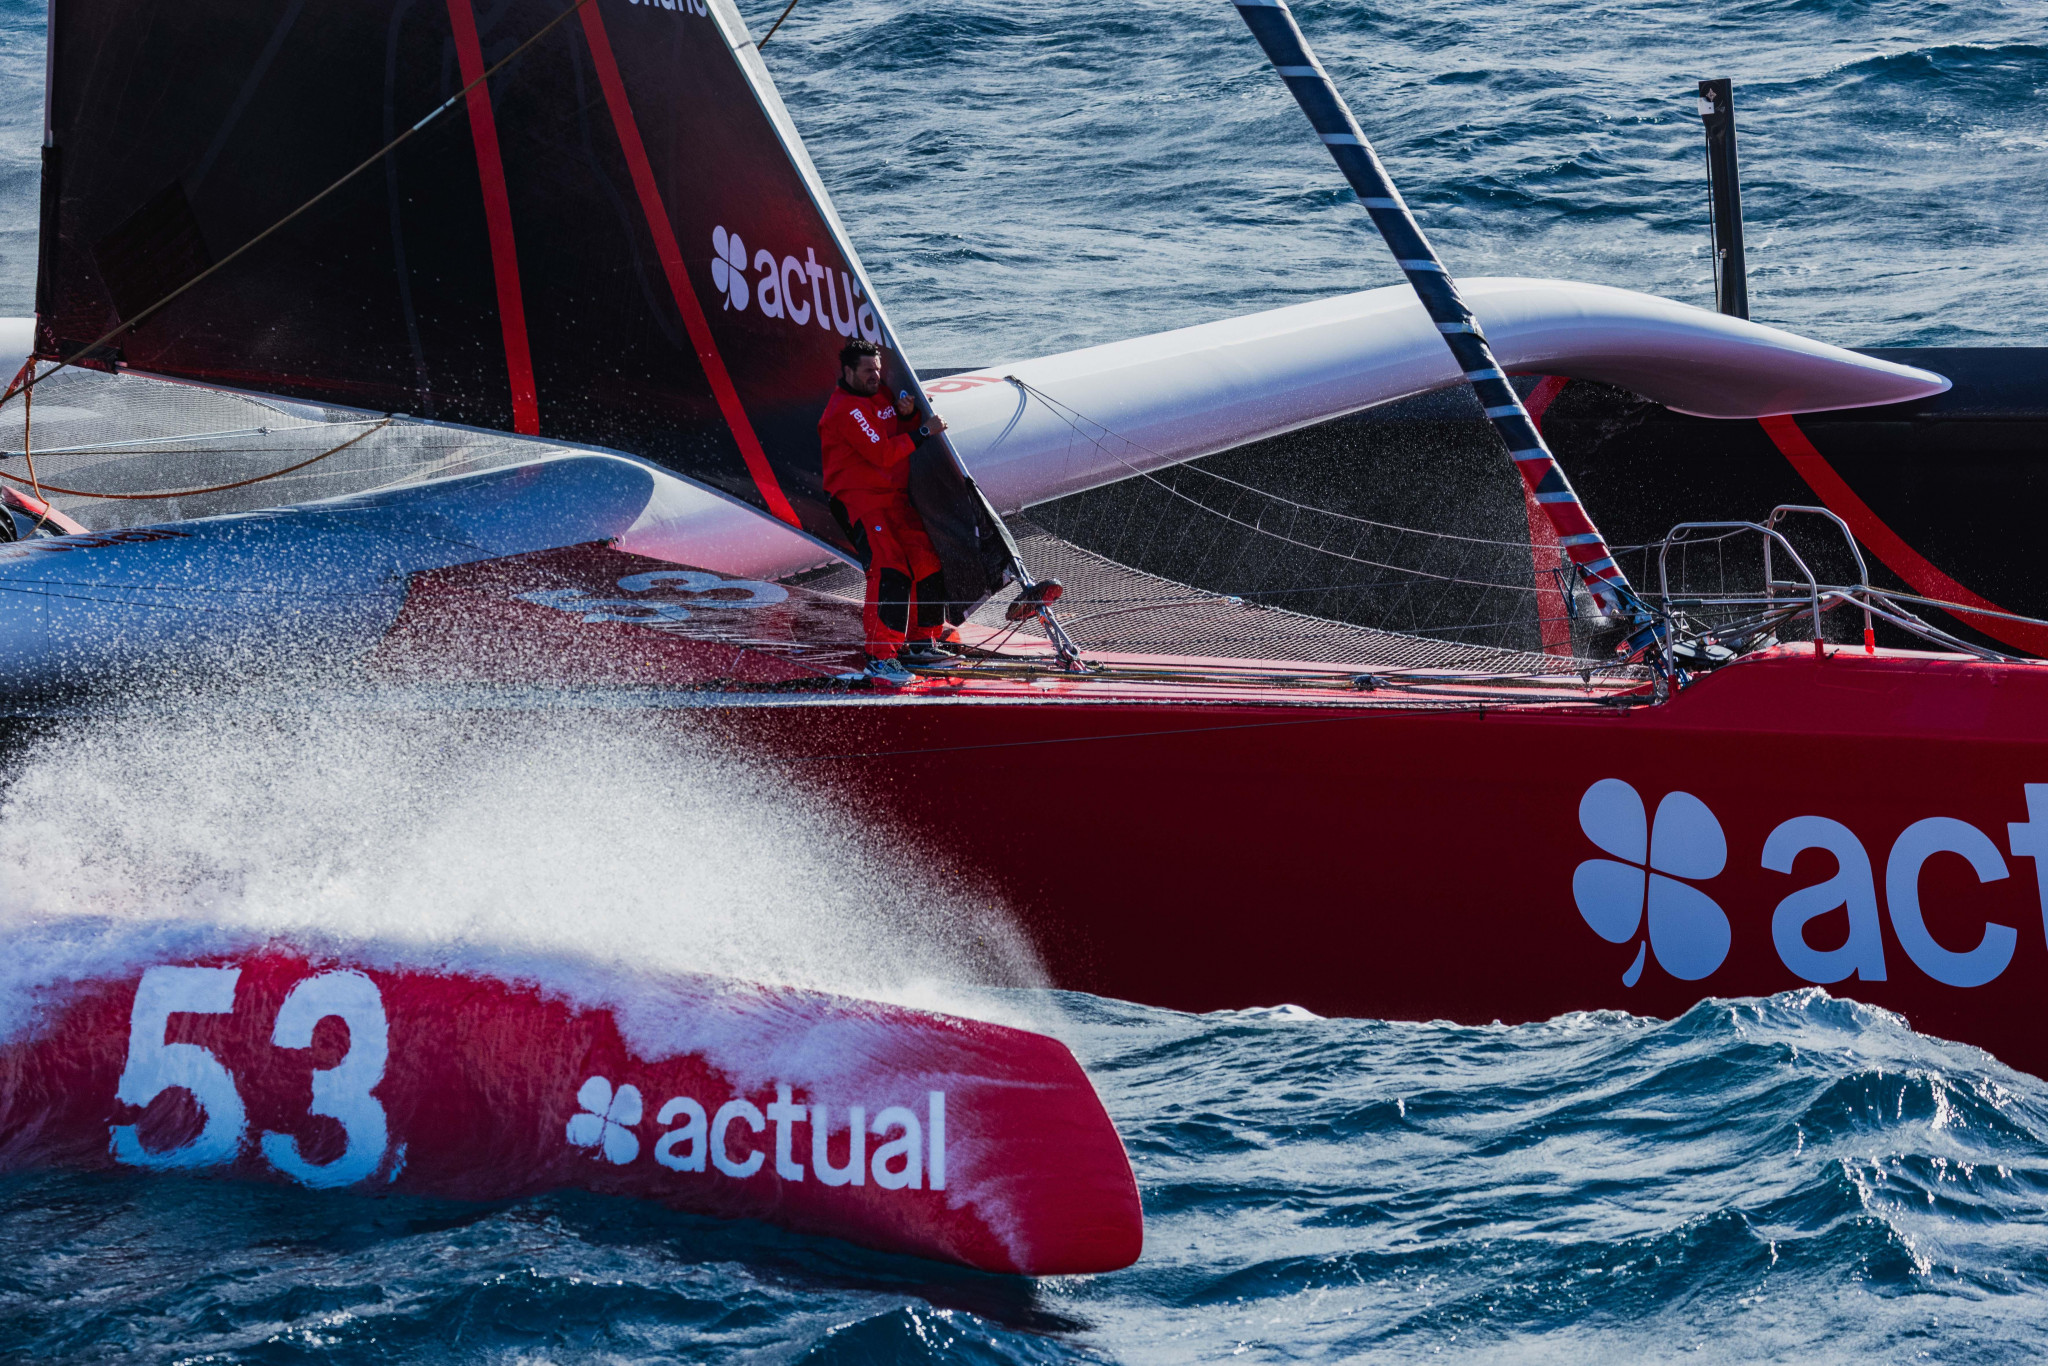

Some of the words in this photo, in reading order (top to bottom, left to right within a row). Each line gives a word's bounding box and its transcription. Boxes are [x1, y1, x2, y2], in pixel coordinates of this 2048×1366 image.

[754, 247, 892, 349] actua
[849, 408, 880, 444] actual
[108, 964, 392, 1190] 53
[655, 1083, 946, 1190] actual
